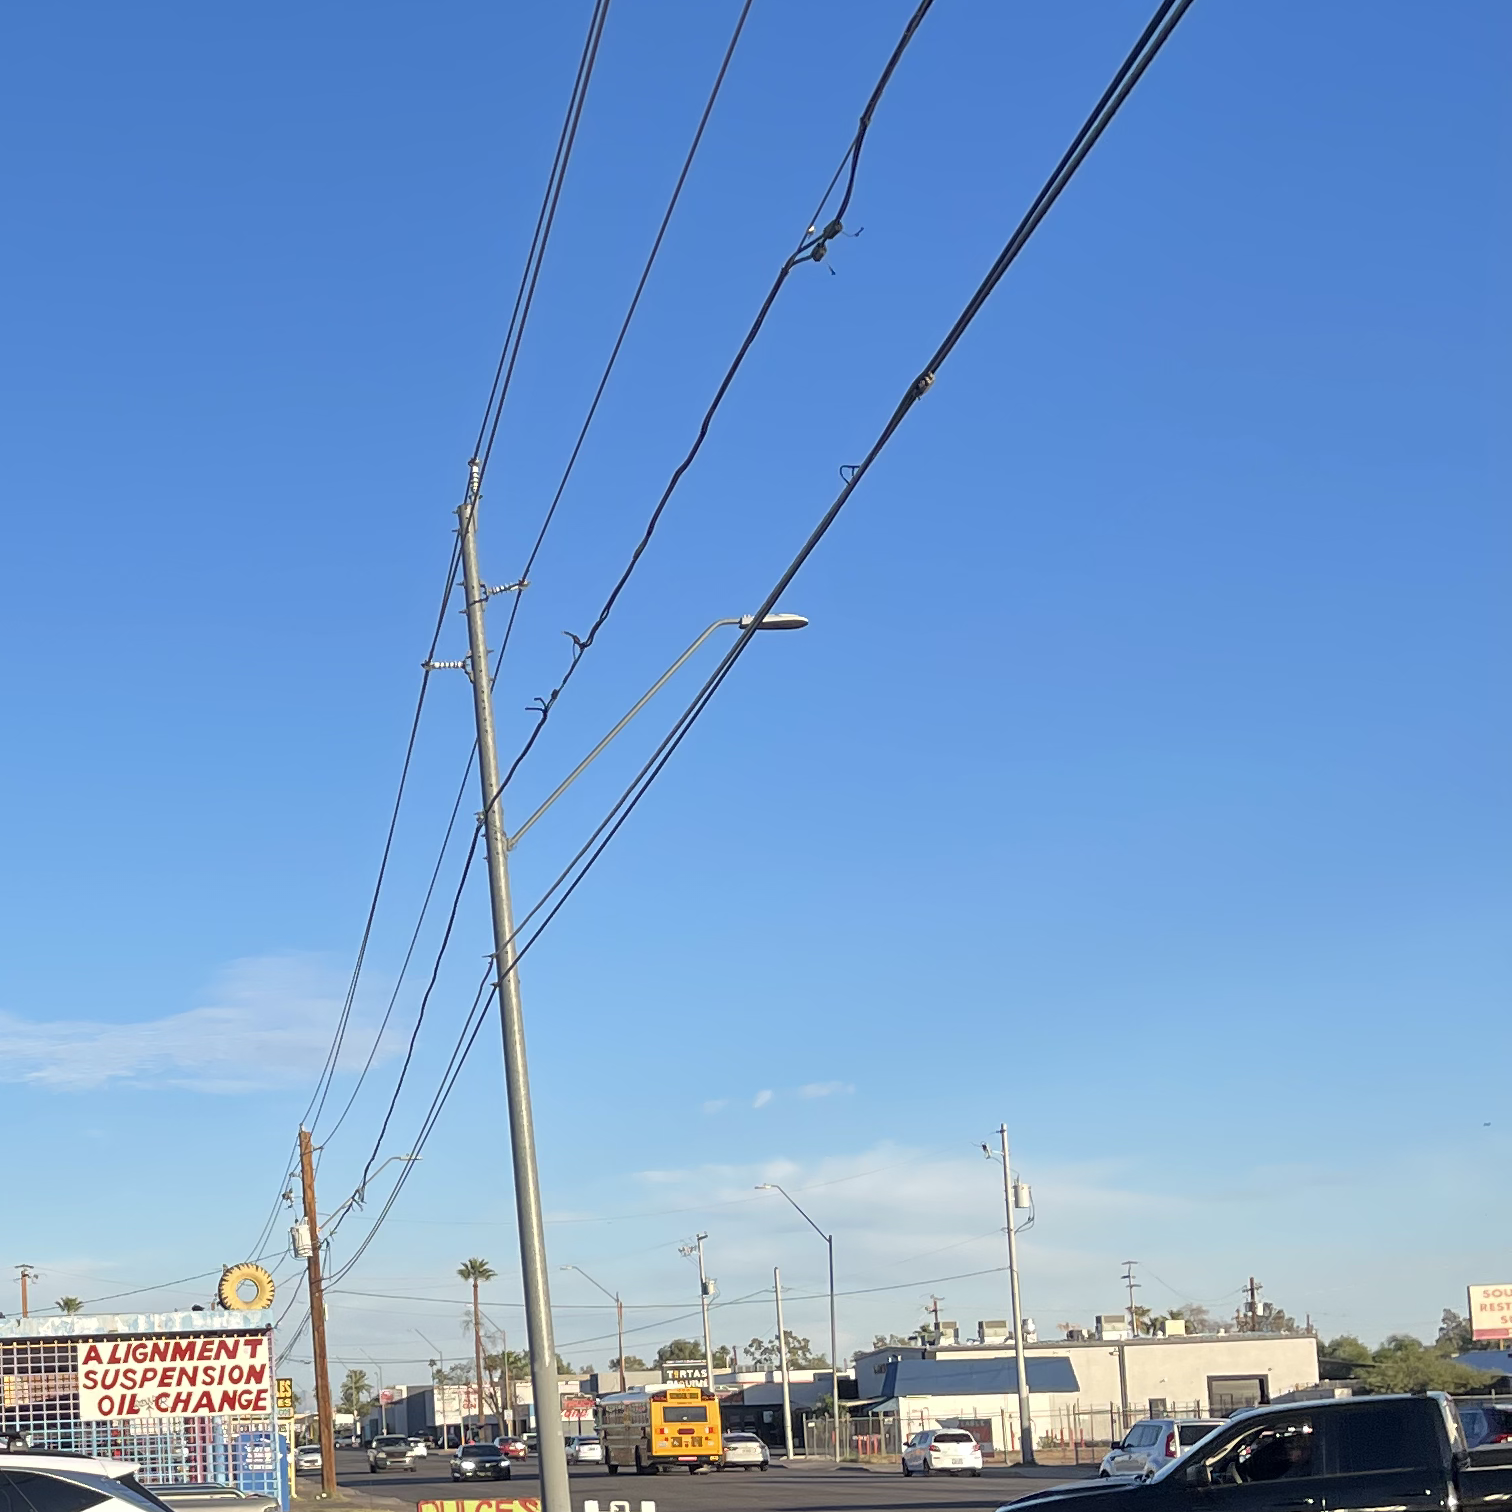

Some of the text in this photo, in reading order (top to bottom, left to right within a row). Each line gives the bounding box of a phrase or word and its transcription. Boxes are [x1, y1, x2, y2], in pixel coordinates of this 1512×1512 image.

[82, 1338, 263, 1365] ALIGNMENT
[82, 1363, 267, 1390] SUSPENSION
[98, 1393, 141, 1416] OIL
[154, 1389, 268, 1413] CHANGE
